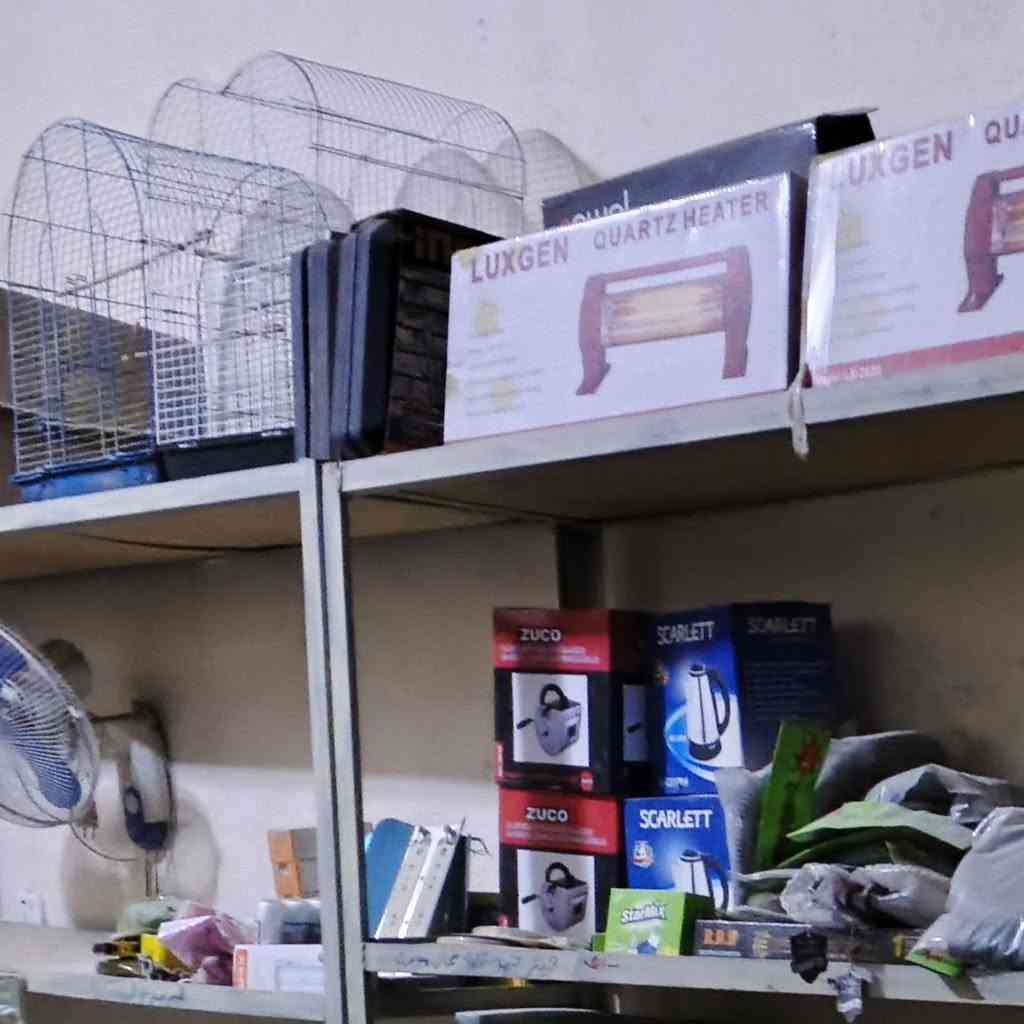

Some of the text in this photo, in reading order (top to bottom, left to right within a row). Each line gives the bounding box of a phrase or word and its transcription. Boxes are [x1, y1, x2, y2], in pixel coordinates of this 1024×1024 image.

[834, 130, 953, 188] UXGEN
[593, 190, 769, 250] QUARTZ HEATER
[471, 236, 569, 284] LUXGEN
[519, 627, 562, 642] ZUCO
[656, 620, 716, 646] SCARLETT
[525, 806, 569, 824] ZUCO
[638, 808, 714, 830] SCARLETT
